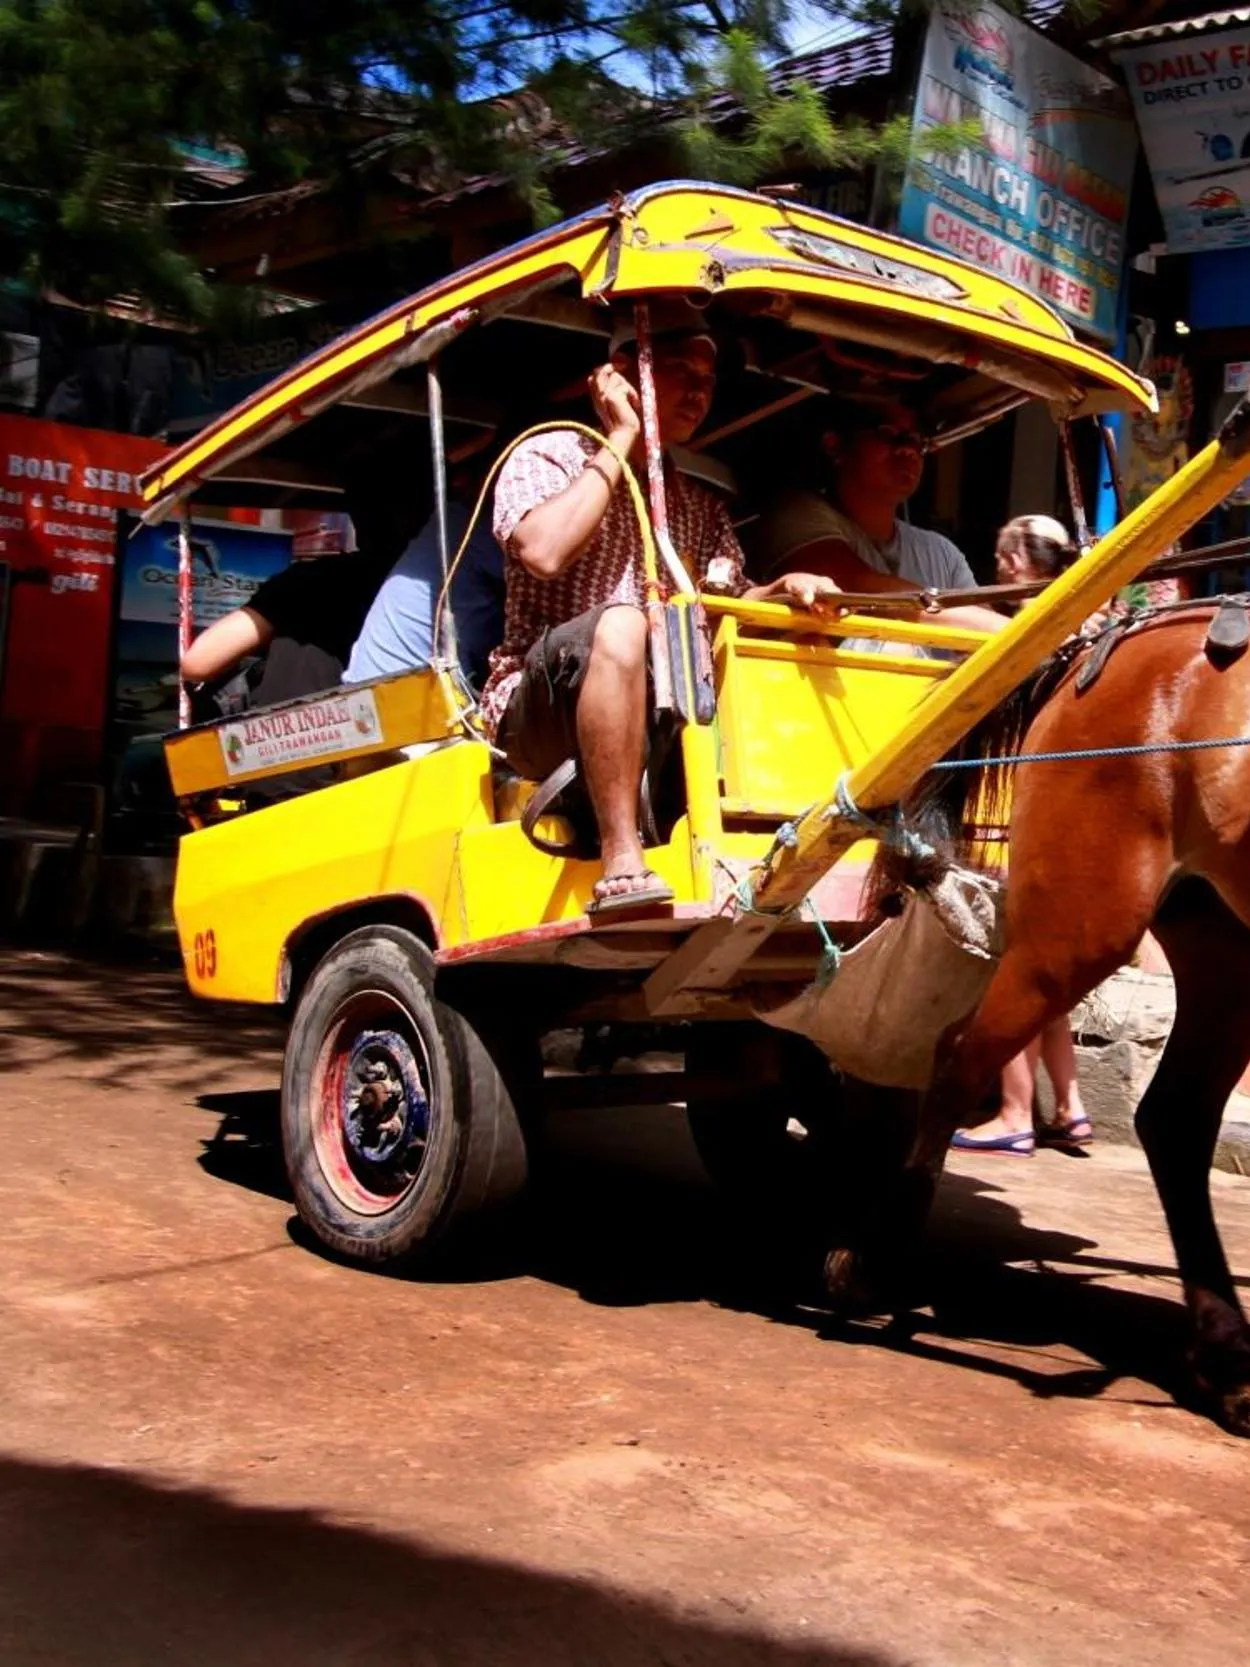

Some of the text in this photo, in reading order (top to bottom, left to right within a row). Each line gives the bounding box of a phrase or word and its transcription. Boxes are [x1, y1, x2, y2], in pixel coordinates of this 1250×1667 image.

[1137, 50, 1219, 86] DAILY
[1143, 82, 1208, 105] DIRECT
[1214, 76, 1243, 91] TO
[922, 147, 1030, 217] RANCH
[1036, 191, 1121, 264] OFFICE
[931, 211, 1006, 273] CHECK
[1010, 251, 1033, 284] IN
[1039, 264, 1093, 316] HERE
[7, 454, 72, 484] BOAT
[143, 568, 215, 588] Ocan
